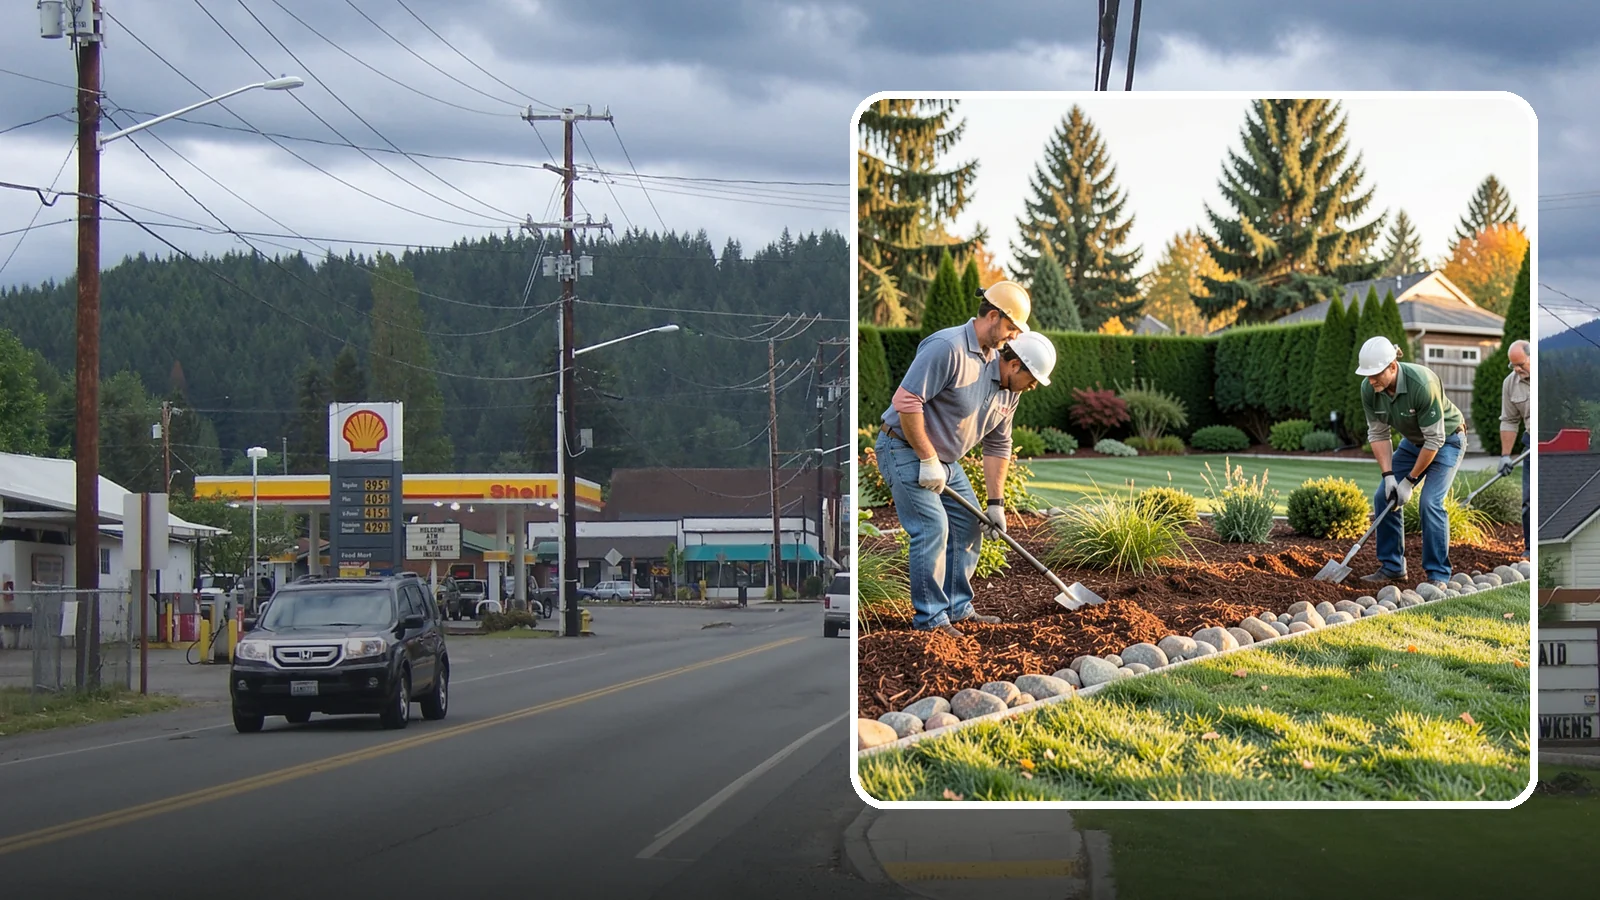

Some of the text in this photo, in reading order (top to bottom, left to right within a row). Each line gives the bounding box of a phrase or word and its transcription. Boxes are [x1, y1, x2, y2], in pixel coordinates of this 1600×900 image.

[365, 480, 384, 490] 395
[490, 484, 548, 499] Shell
[365, 494, 384, 504] 405
[365, 508, 384, 518] 415
[365, 522, 384, 532] 429
[1538, 643, 1567, 665] AID
